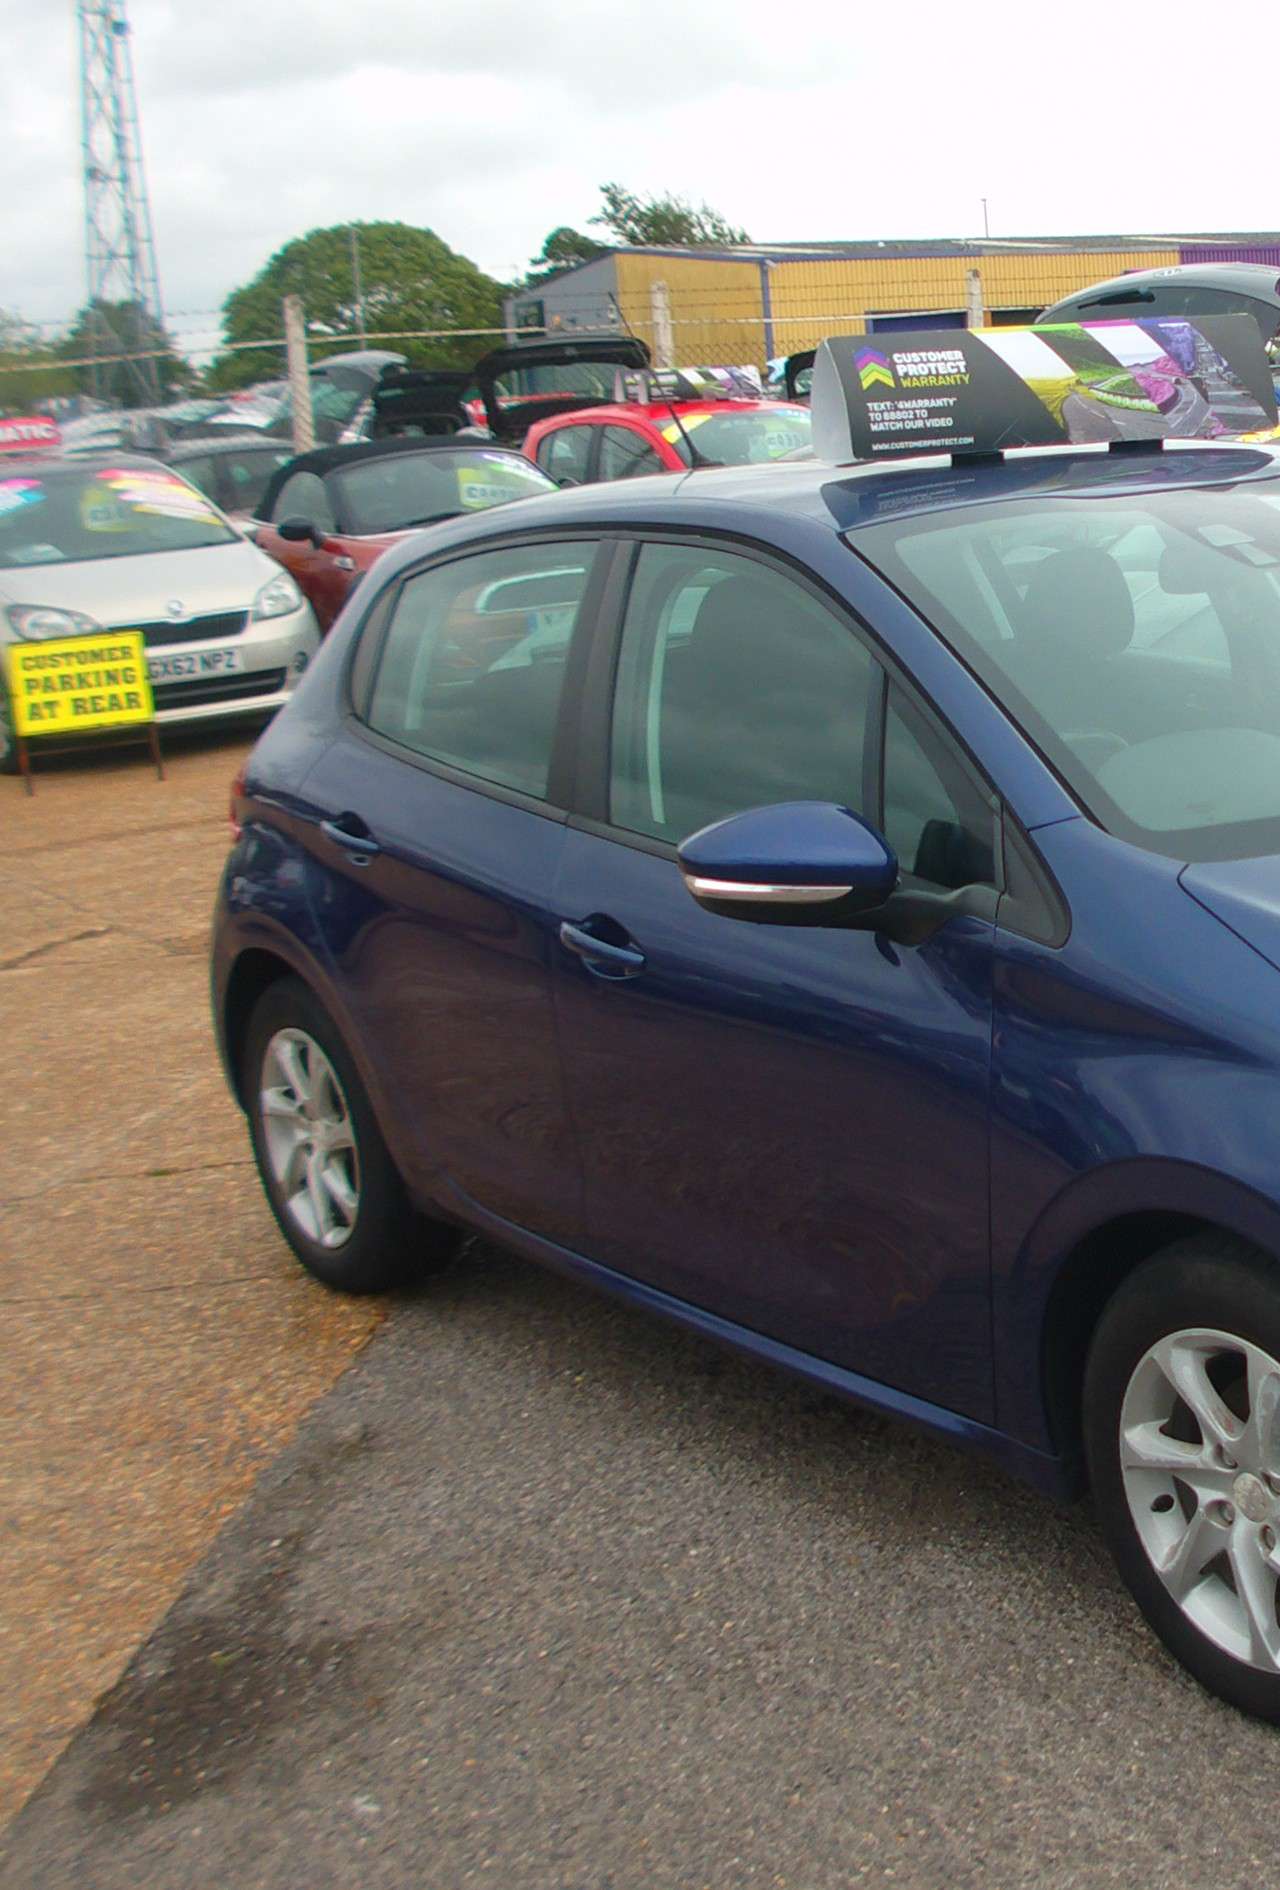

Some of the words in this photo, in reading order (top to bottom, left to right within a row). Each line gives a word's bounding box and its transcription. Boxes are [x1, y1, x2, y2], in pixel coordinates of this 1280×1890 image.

[892, 350, 964, 364] CUSTOMER
[896, 361, 967, 376] PROTECT
[901, 374, 971, 388] WARRANTY
[869, 412, 882, 421] TO
[915, 409, 928, 419] TO
[870, 421, 903, 432] WATCH
[904, 419, 924, 430] OUR
[925, 417, 953, 428] VIDEO
[21, 645, 134, 672] CUSTOMER
[24, 667, 137, 696] PARKING
[28, 699, 60, 721] AT
[71, 691, 142, 716] REAR
